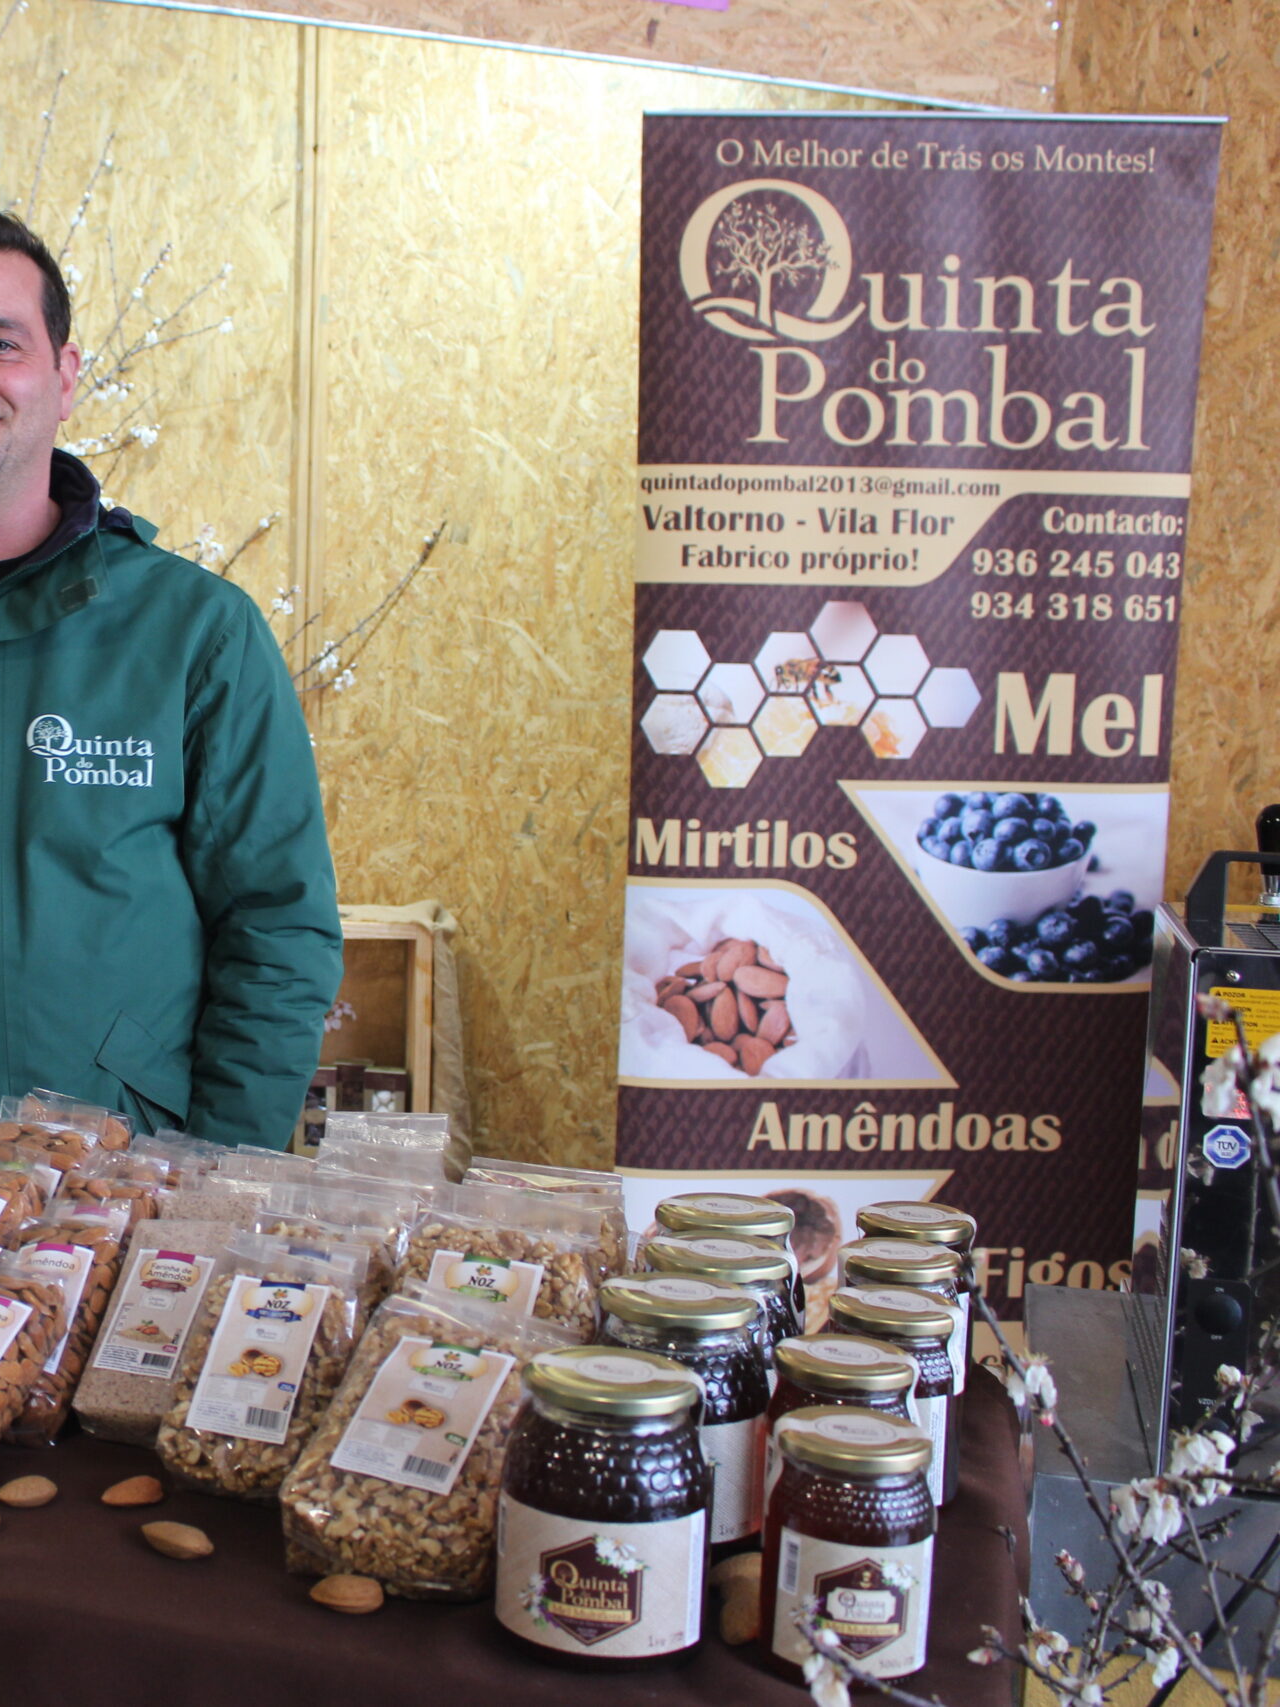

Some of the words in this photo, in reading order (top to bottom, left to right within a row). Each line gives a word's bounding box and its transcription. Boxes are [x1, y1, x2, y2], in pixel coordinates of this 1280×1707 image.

[716, 139, 744, 167] O
[752, 139, 863, 169] Melhor
[871, 140, 909, 169] de
[918, 142, 983, 171] Trás
[991, 150, 1025, 171] os
[1034, 145, 1156, 174] Montes!
[679, 178, 1156, 341] Quinta
[870, 341, 926, 383] do
[746, 344, 1151, 451] Pombal
[640, 473, 1001, 497] quintadopombal2013@gmail.com
[642, 505, 785, 533] Valtorno
[818, 508, 878, 534] Vila
[891, 509, 955, 536] Flor
[1043, 506, 1184, 536] Contacto:
[681, 544, 790, 570] Fabrico
[801, 547, 919, 574] próprio!
[972, 549, 1038, 577] 936
[1050, 550, 1115, 578] 245
[1126, 551, 1181, 579] 043
[971, 592, 1035, 620] 934
[1048, 593, 1112, 621] 318
[1124, 594, 1177, 622] 651
[994, 672, 1163, 757] Mel
[26, 714, 155, 757] Quinta
[43, 757, 153, 787] Pombal
[76, 757, 93, 769] do
[634, 818, 858, 870] Mirtilos
[746, 1101, 1062, 1153] Amêndoas
[468, 1275, 496, 1288] NOZ
[265, 1299, 291, 1310] NOZ
[434, 1360, 463, 1371] NOZ
[550, 1561, 628, 1593] Quinta
[561, 1587, 628, 1610] Pombal
